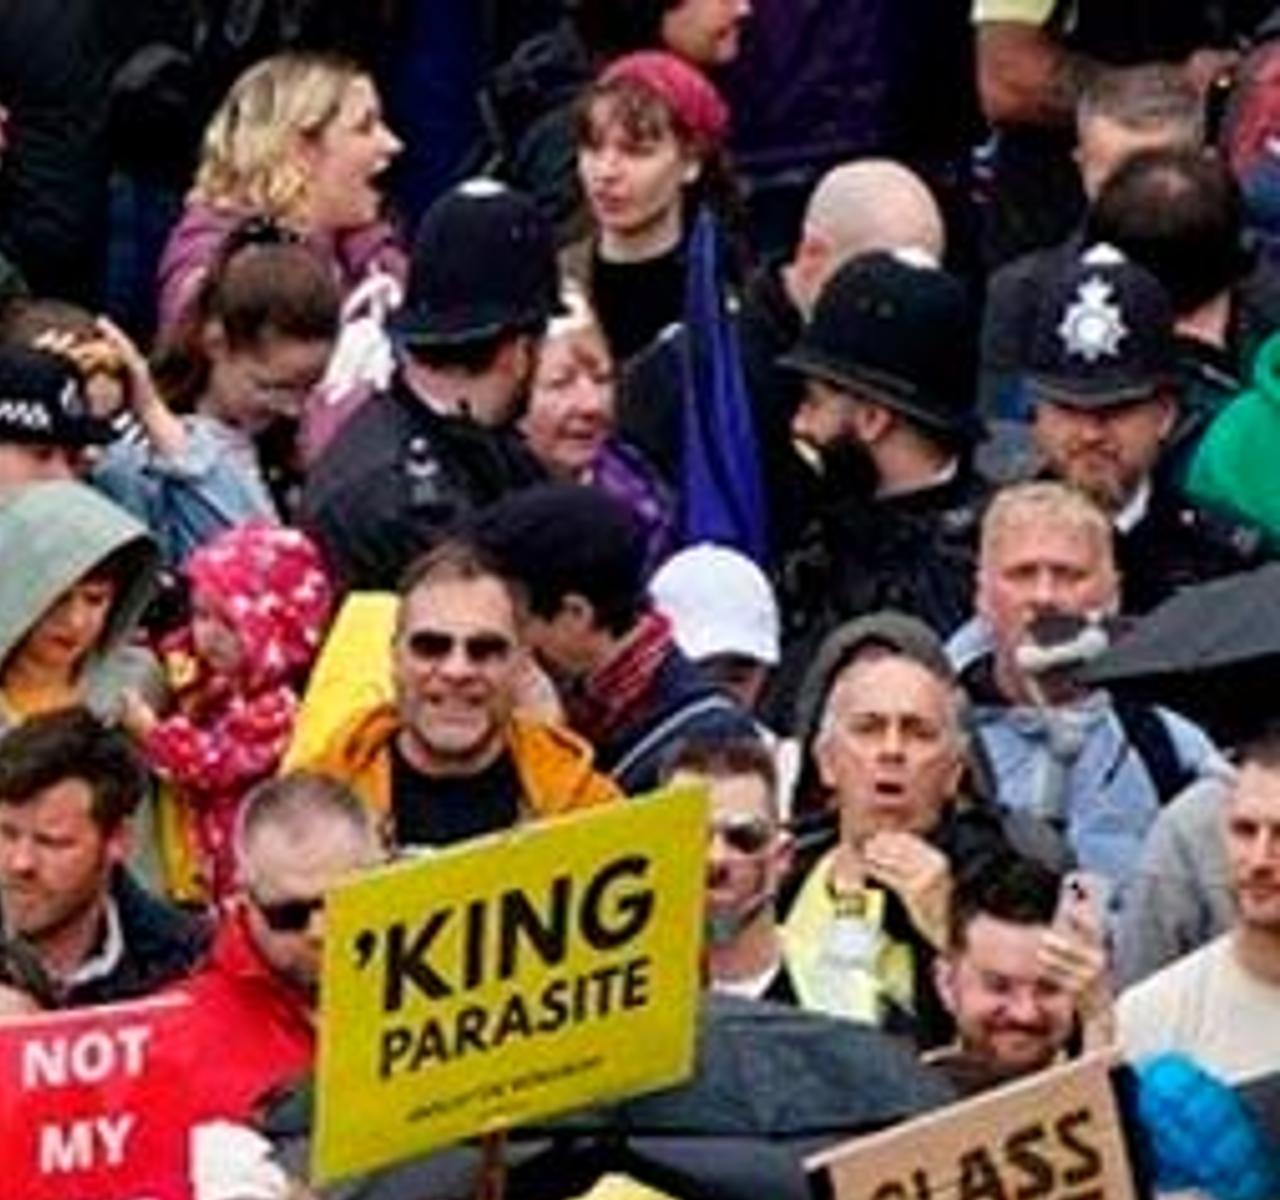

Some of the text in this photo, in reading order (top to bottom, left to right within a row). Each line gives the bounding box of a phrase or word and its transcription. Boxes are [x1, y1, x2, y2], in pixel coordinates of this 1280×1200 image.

[380, 956, 651, 1080] PARASITE
[21, 1025, 153, 1090] NOT
[40, 1114, 135, 1175] MY
